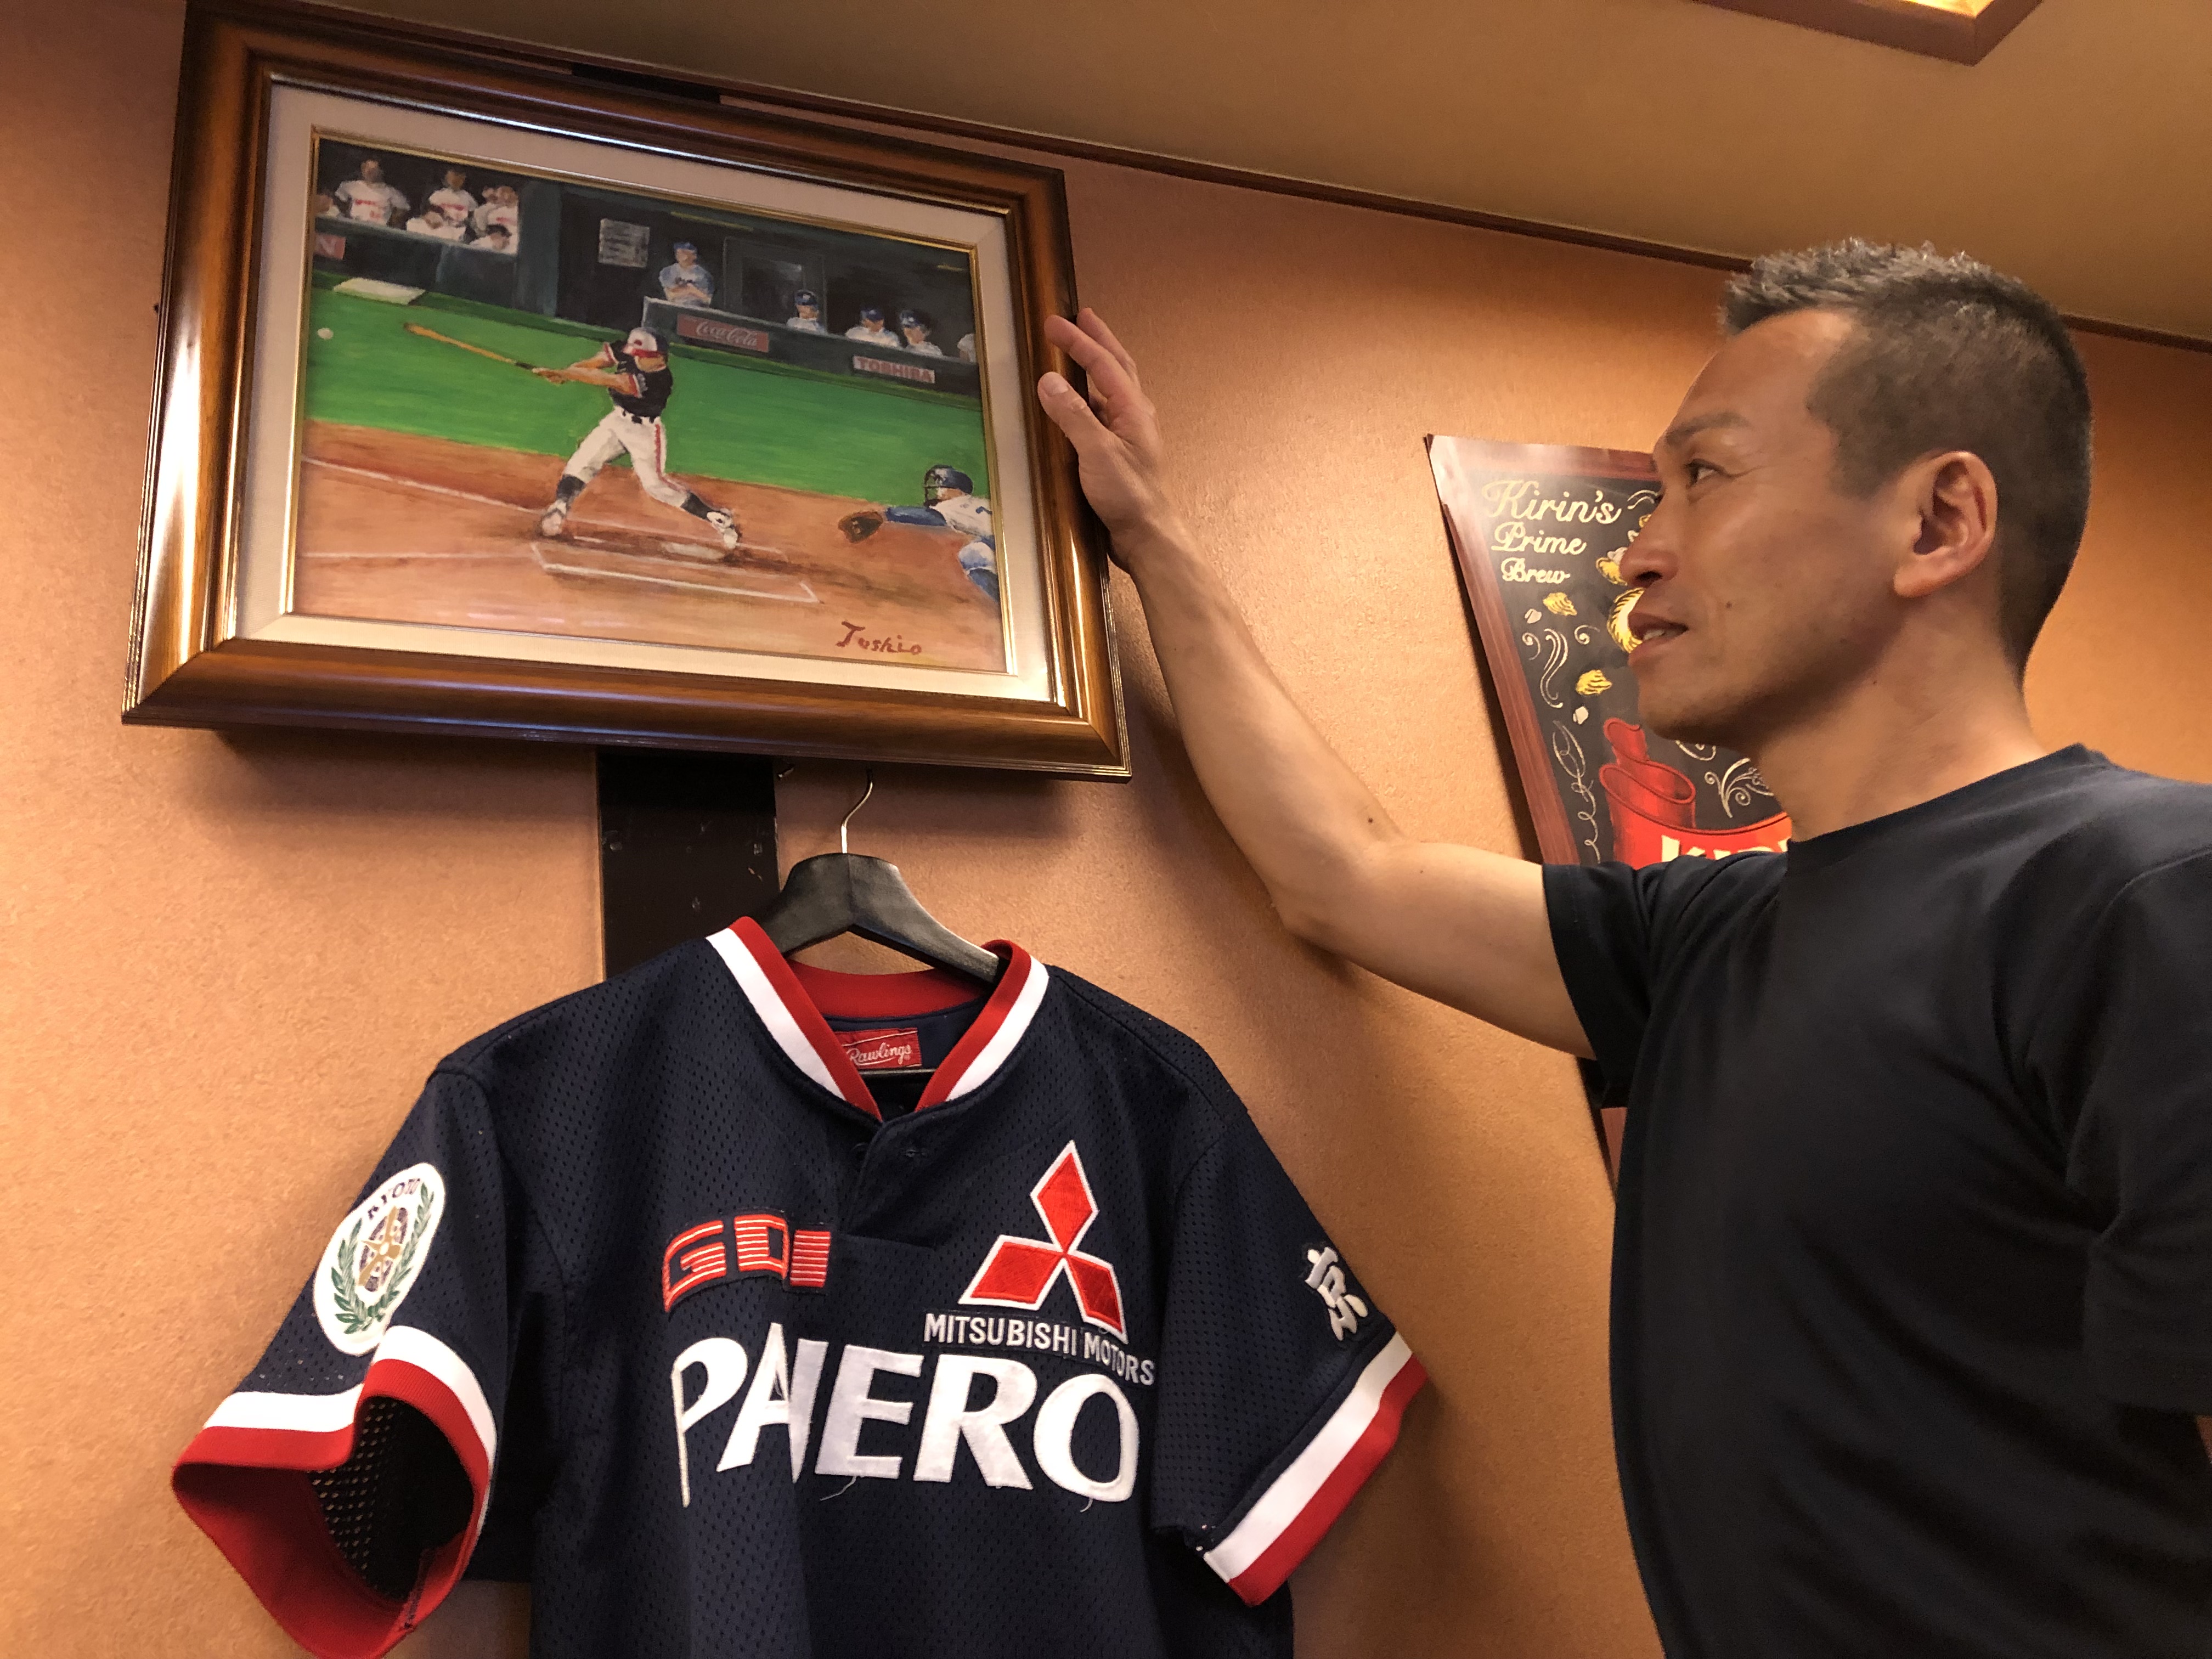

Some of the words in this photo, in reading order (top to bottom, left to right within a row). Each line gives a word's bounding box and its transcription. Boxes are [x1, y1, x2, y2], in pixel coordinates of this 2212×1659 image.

[1483, 479, 1622, 524] Kirin's
[1491, 521, 1587, 555] Prime
[1500, 557, 1571, 584] Brew
[836, 620, 922, 656] Toshio
[847, 1042, 912, 1065] Rawlings
[1304, 1246, 1368, 1341] 京
[923, 1313, 1077, 1356] MITSUBISHI
[1084, 1331, 1155, 1385] MOTORS
